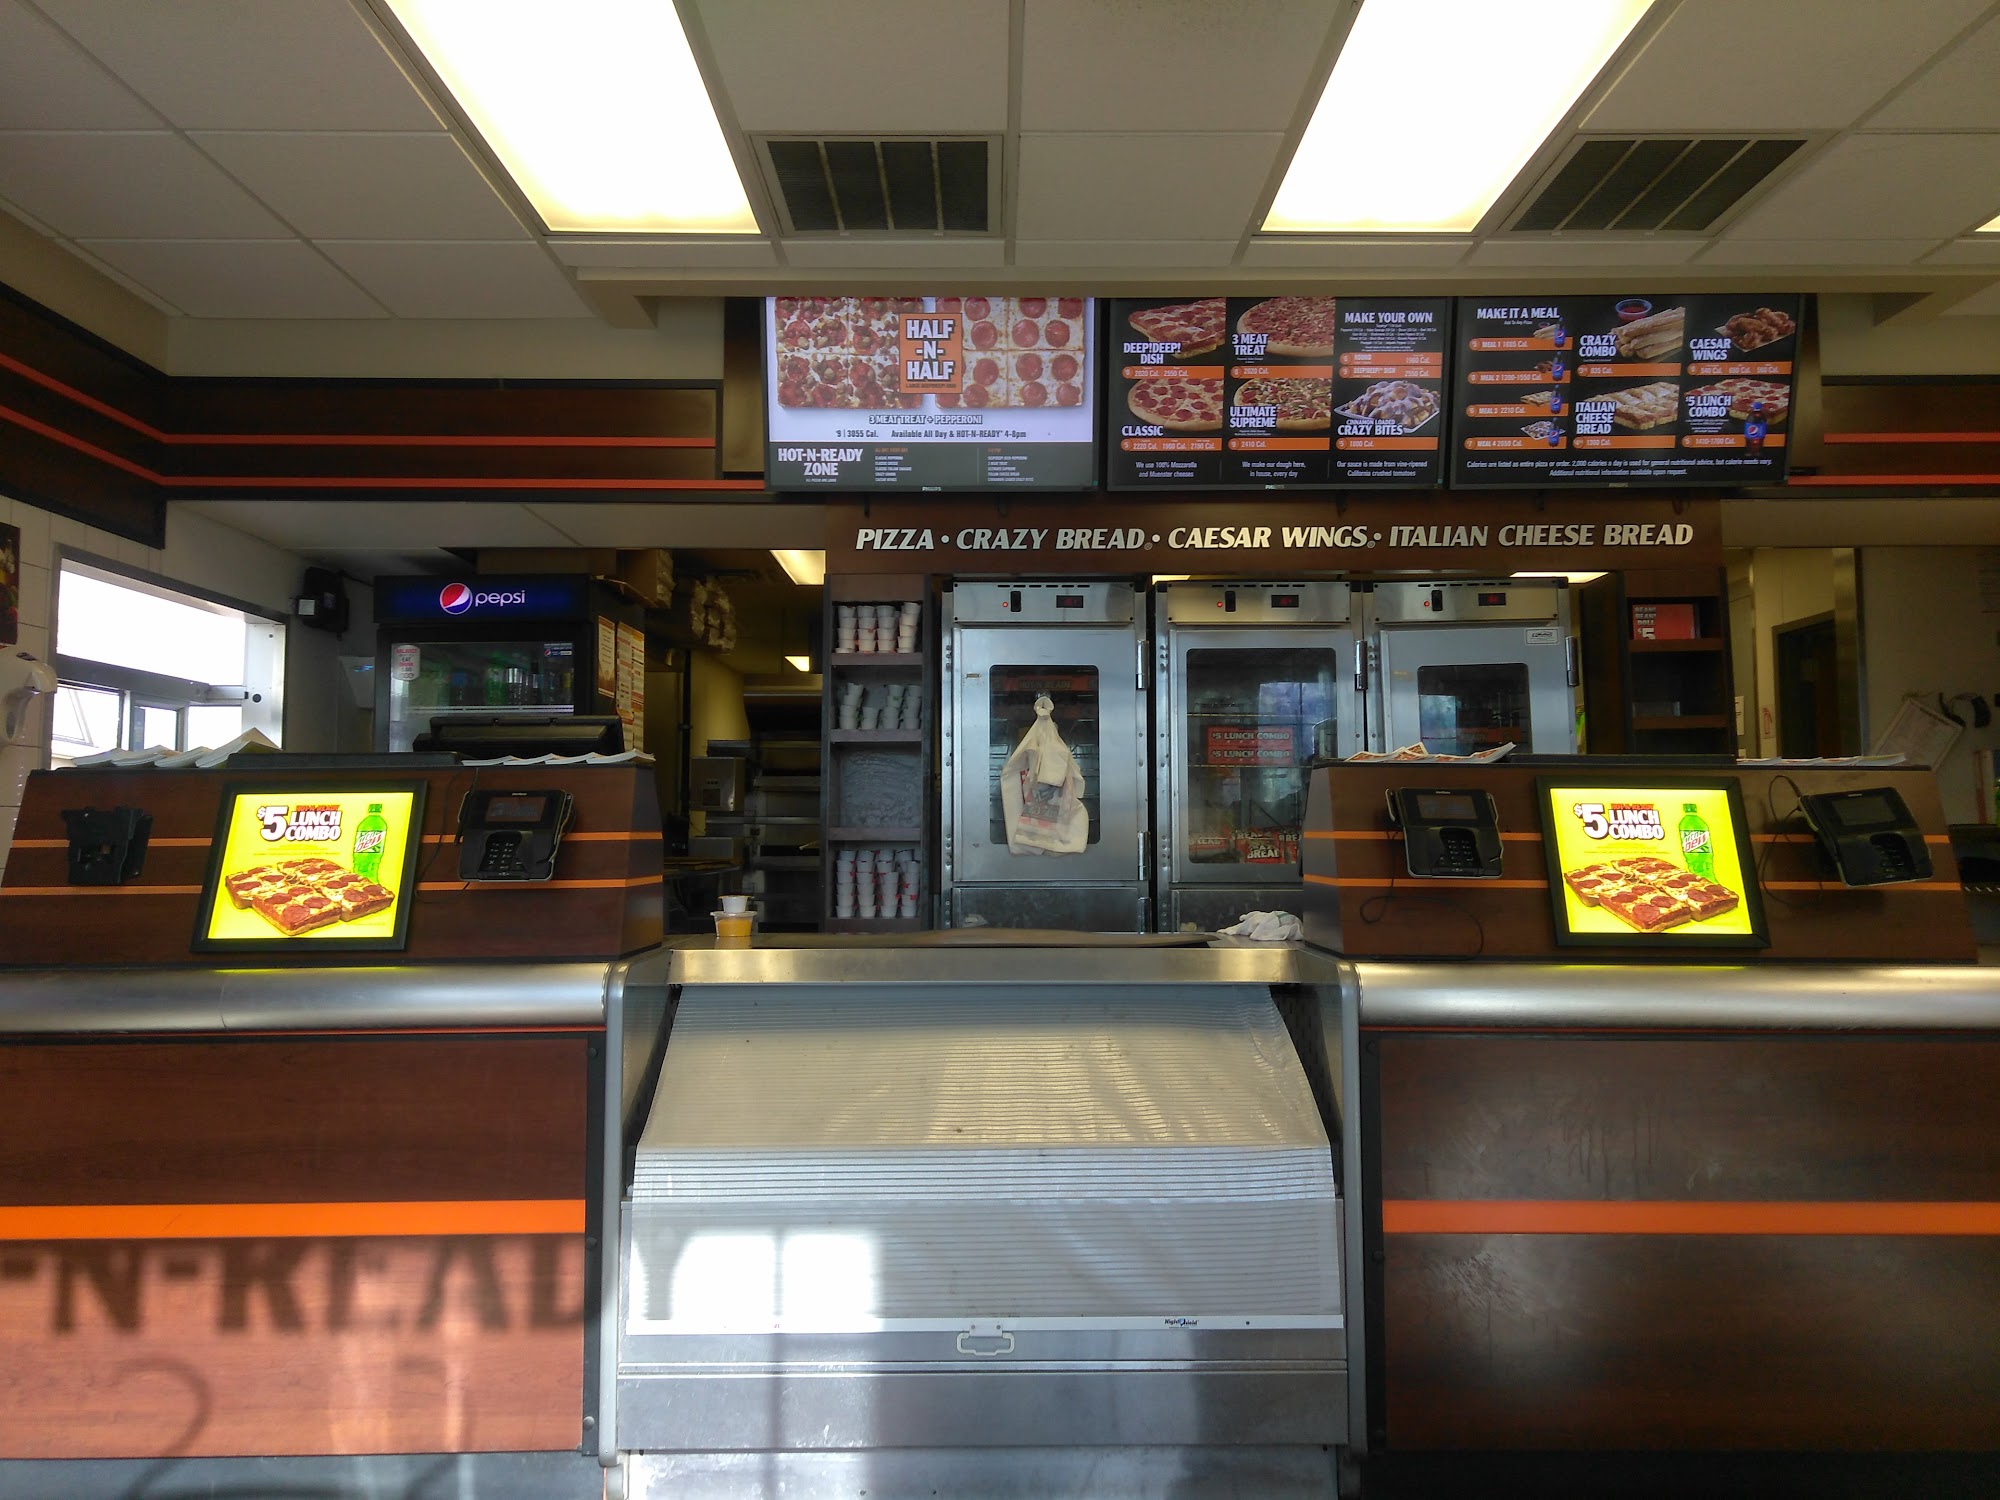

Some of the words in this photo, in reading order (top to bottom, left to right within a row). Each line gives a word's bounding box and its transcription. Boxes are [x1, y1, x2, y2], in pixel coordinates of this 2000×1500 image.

[1344, 312, 1375, 323] MAKE
[1378, 312, 1405, 323] YOUR
[1408, 312, 1433, 323] OWN
[1477, 307, 1507, 319] MAKE
[1509, 307, 1520, 319] IT
[1520, 307, 1528, 319] A
[1531, 307, 1560, 319] MEAL
[906, 319, 954, 339] HALF
[1232, 334, 1239, 344] 3
[1240, 334, 1268, 344] MEAT
[1580, 335, 1616, 345] CRAZY
[1689, 338, 1731, 349] CAESAR
[916, 341, 945, 359] -N-
[1123, 342, 1181, 353] DEEP!DEEP!
[1234, 345, 1265, 355] TREAT
[1579, 346, 1616, 356] COMBO
[1140, 353, 1164, 364] DISH
[1692, 349, 1728, 360] WINGS
[907, 360, 954, 380] HALF
[1685, 395, 1695, 406] $5
[1697, 395, 1732, 406] LUNCH
[1229, 406, 1276, 416] ULTIMATE
[1575, 401, 1615, 412] ITALIAN
[1688, 406, 1726, 417] COMBO
[869, 415, 876, 425] 3
[876, 415, 899, 425] MEAT
[901, 415, 926, 425] TREAT
[934, 415, 982, 425] PEPPERONI
[1229, 417, 1276, 427] SUPREME
[1575, 413, 1614, 423] CHEESE
[847, 430, 864, 438] 3055
[866, 430, 879, 438] Cal.
[1121, 425, 1164, 436] CLASSIC
[1337, 425, 1373, 435] CRAZY
[1375, 425, 1403, 435] BITES
[1576, 423, 1611, 434] BREAD
[891, 430, 921, 439] Available
[924, 430, 933, 439] All
[935, 430, 947, 439] Day
[949, 430, 955, 439] &
[1005, 430, 1026, 439] 4-8pm
[778, 448, 863, 462] HOT-N-READY
[804, 462, 839, 476] ZONE
[1242, 461, 1251, 469] We
[1251, 461, 1265, 469] make
[1276, 461, 1292, 469] dough
[1535, 460, 1548, 468] pizza
[1572, 460, 1586, 468] 2,000
[1613, 460, 1622, 468] day
[1273, 470, 1287, 478] every
[1288, 470, 1298, 478] day
[855, 528, 934, 550] PIZZA
[956, 528, 1049, 550] CRAZY
[1168, 526, 1272, 549] CAESAR
[1389, 525, 1489, 547] ITALIAN
[1498, 524, 1595, 547] CHEESE
[1602, 524, 1694, 546] BREAD
[475, 589, 526, 607] pepsi
[1224, 732, 1254, 740] LUNCH
[1257, 732, 1289, 740] COMBO
[1224, 750, 1254, 758] LUNCH
[1257, 750, 1289, 758] COMBO
[256, 805, 289, 841] $5
[289, 811, 342, 826] LUNCH
[1573, 803, 1609, 839] $5
[1608, 809, 1661, 825] LUNCH
[285, 825, 342, 841] COMBO
[1608, 824, 1665, 840] COMBO
